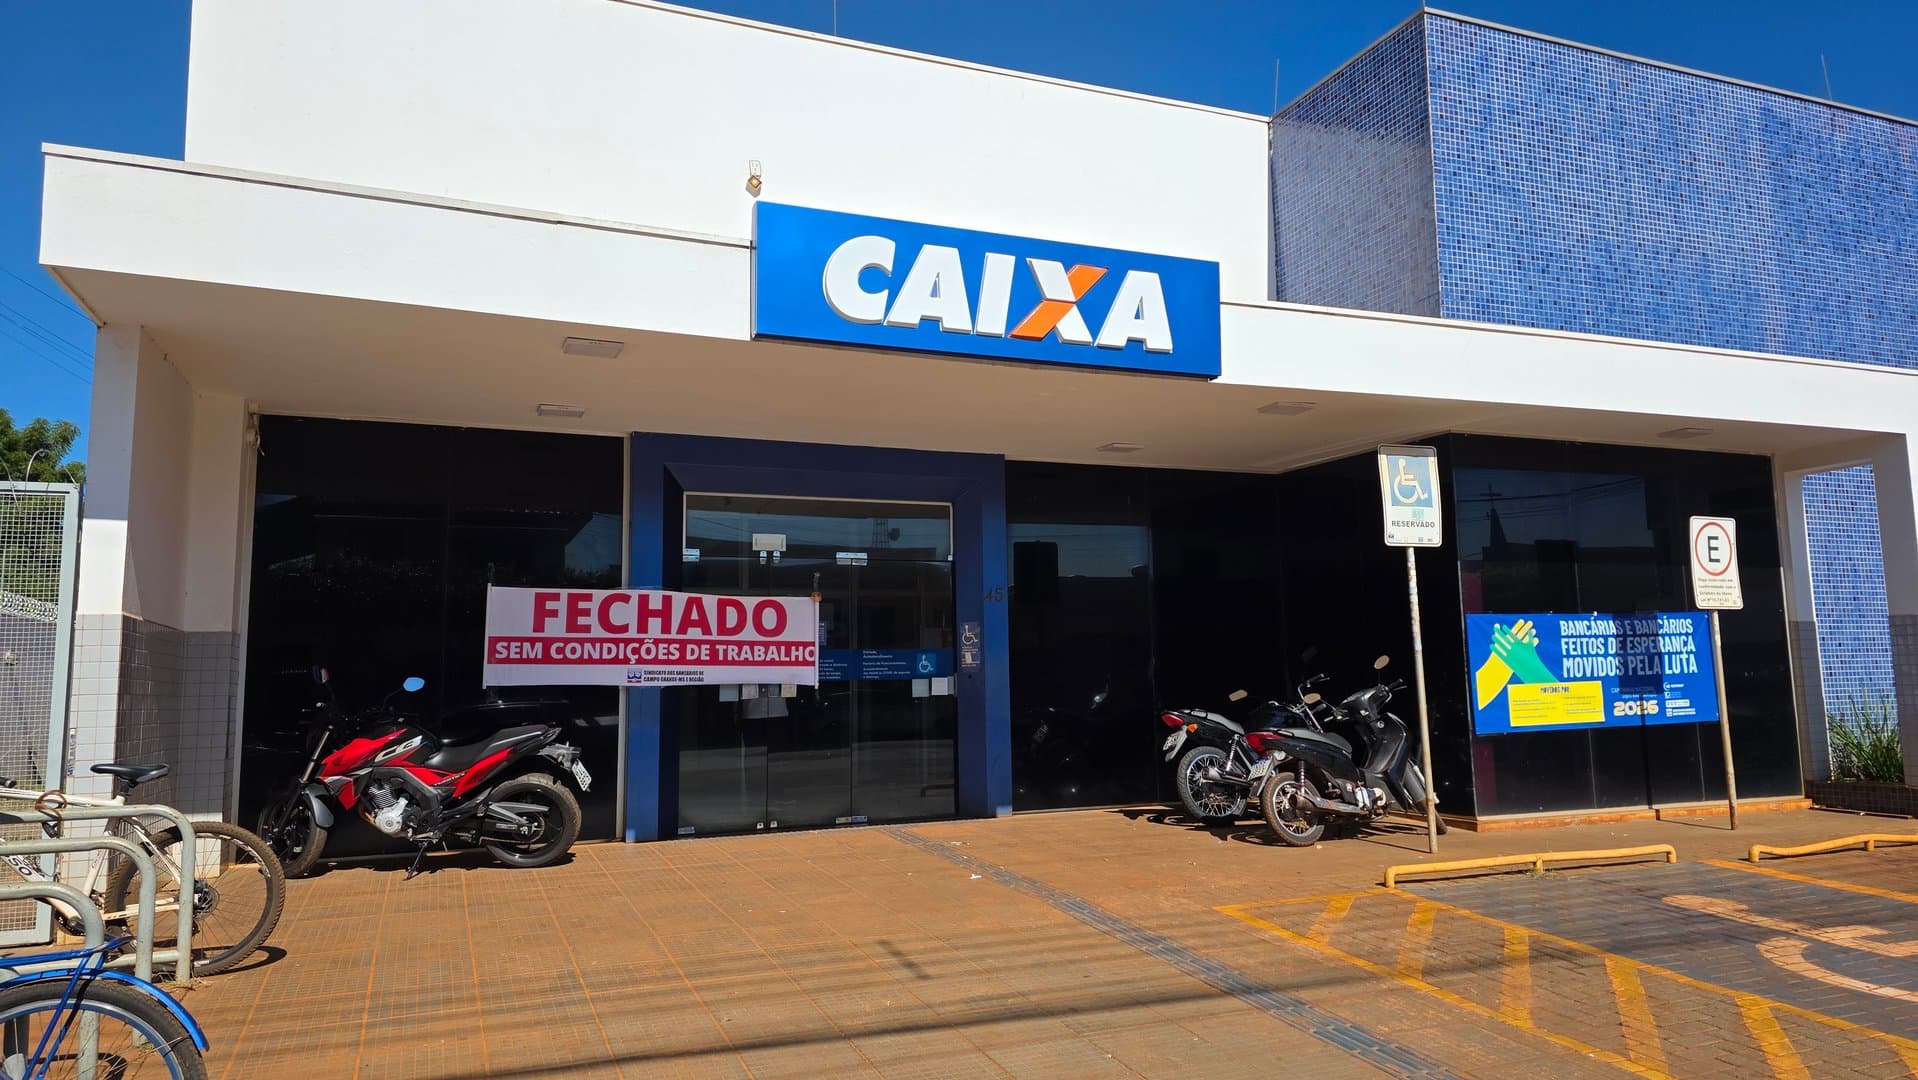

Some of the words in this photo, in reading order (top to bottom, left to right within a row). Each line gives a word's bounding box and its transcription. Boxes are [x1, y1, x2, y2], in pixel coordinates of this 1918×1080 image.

[822, 234, 1174, 354] CAIXA
[1391, 520, 1436, 529] RESERVADO
[1707, 535, 1721, 563] E
[532, 591, 788, 638] FECHADO
[1559, 616, 1624, 636] BANCÁRIAS
[1625, 619, 1633, 635] E
[1634, 615, 1694, 635] BANCÁRIOS
[495, 641, 543, 659] SEM
[550, 639, 680, 665] CONDIÇÕES
[686, 644, 710, 661] DE
[715, 645, 816, 663] TRABALHO
[1561, 637, 1605, 656] FEITOS
[1607, 637, 1624, 655] DE
[1627, 635, 1696, 654] ESPERANÇA
[1562, 656, 1625, 678] MOVIDOS
[1627, 655, 1662, 676] PELA
[1664, 653, 1698, 675] LUTA
[1612, 700, 1660, 717] 2026
